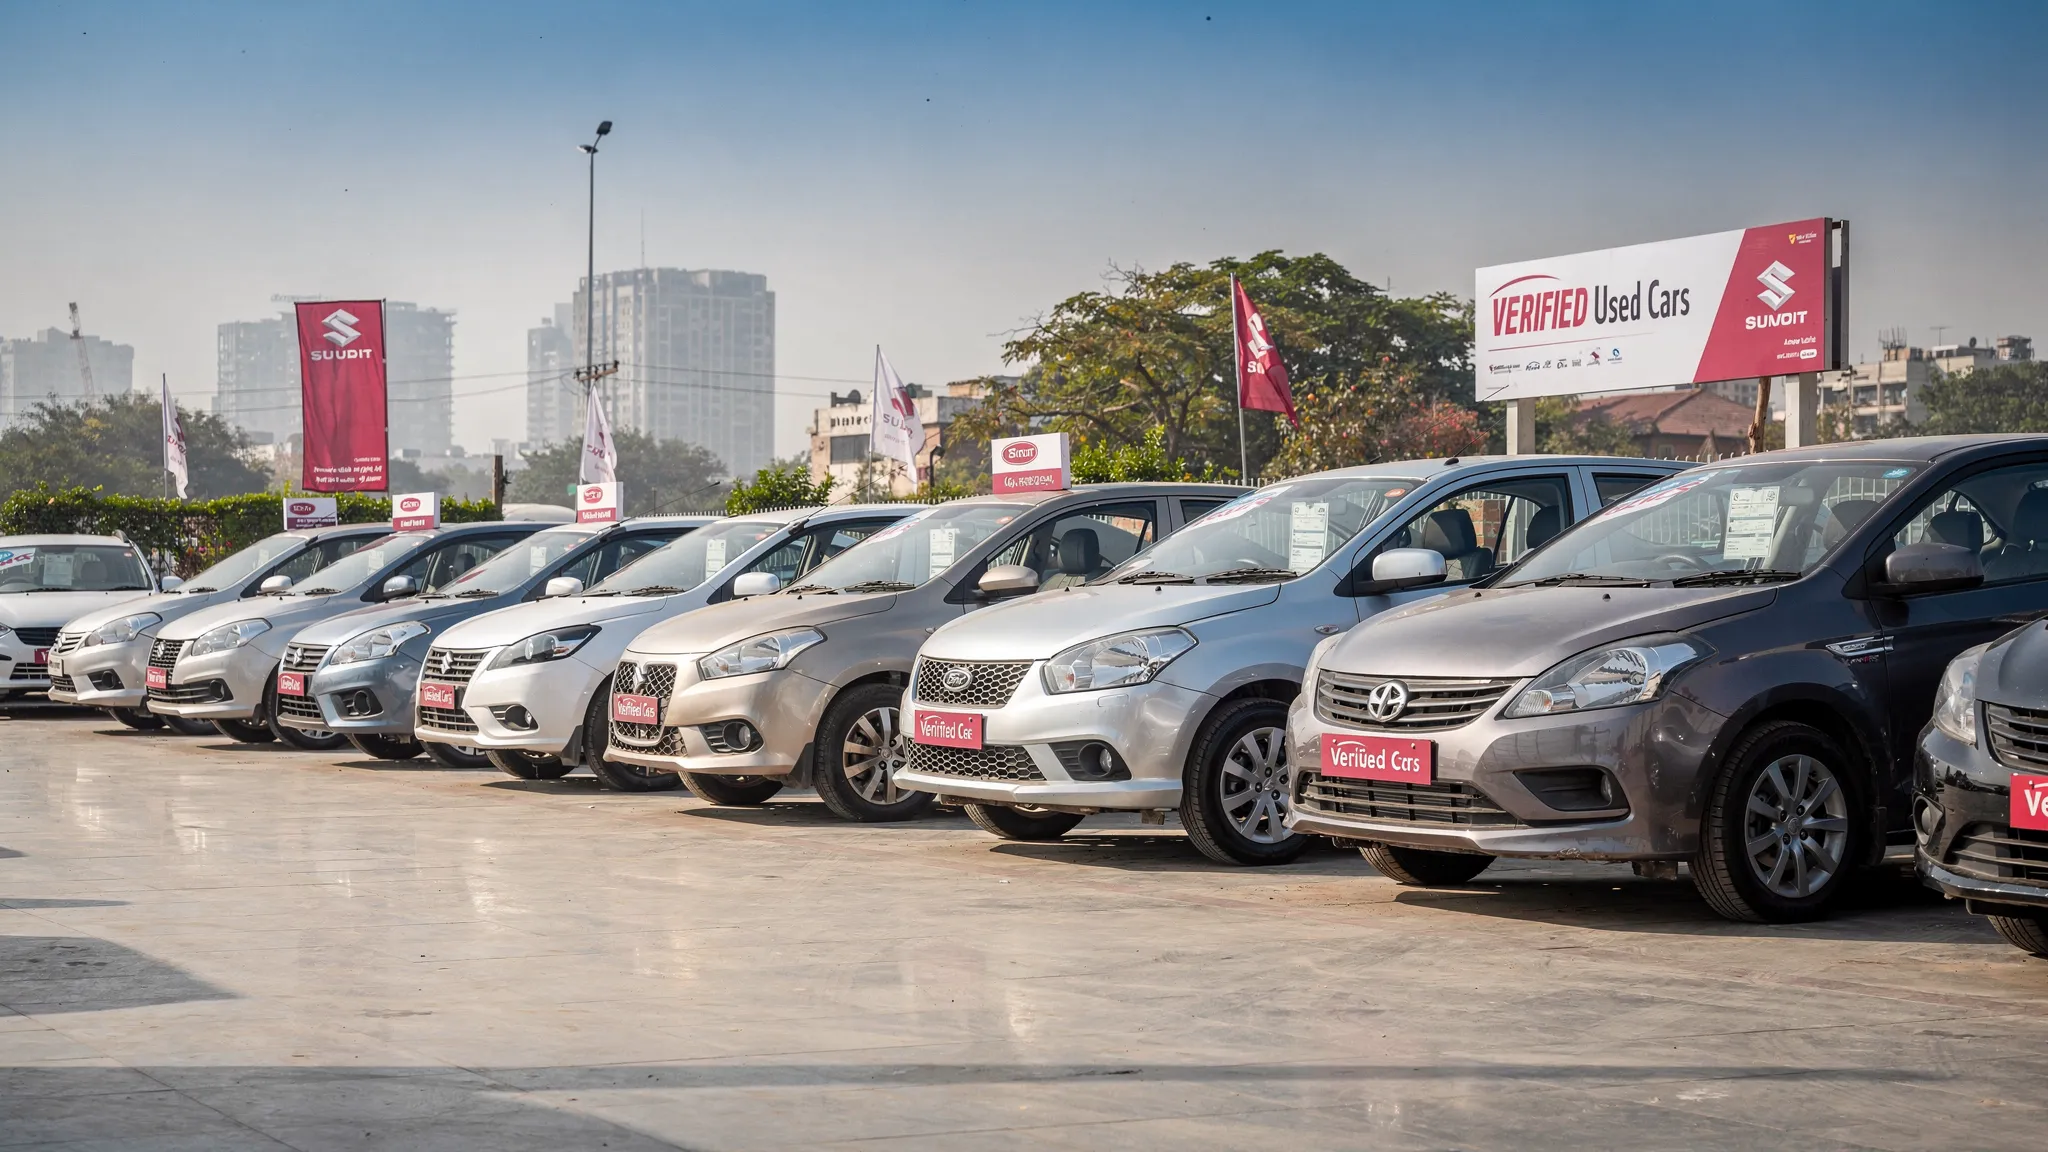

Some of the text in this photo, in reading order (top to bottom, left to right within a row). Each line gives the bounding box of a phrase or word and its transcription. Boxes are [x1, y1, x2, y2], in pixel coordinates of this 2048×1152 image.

[1493, 279, 1690, 336] VERIFIED Used Cars
